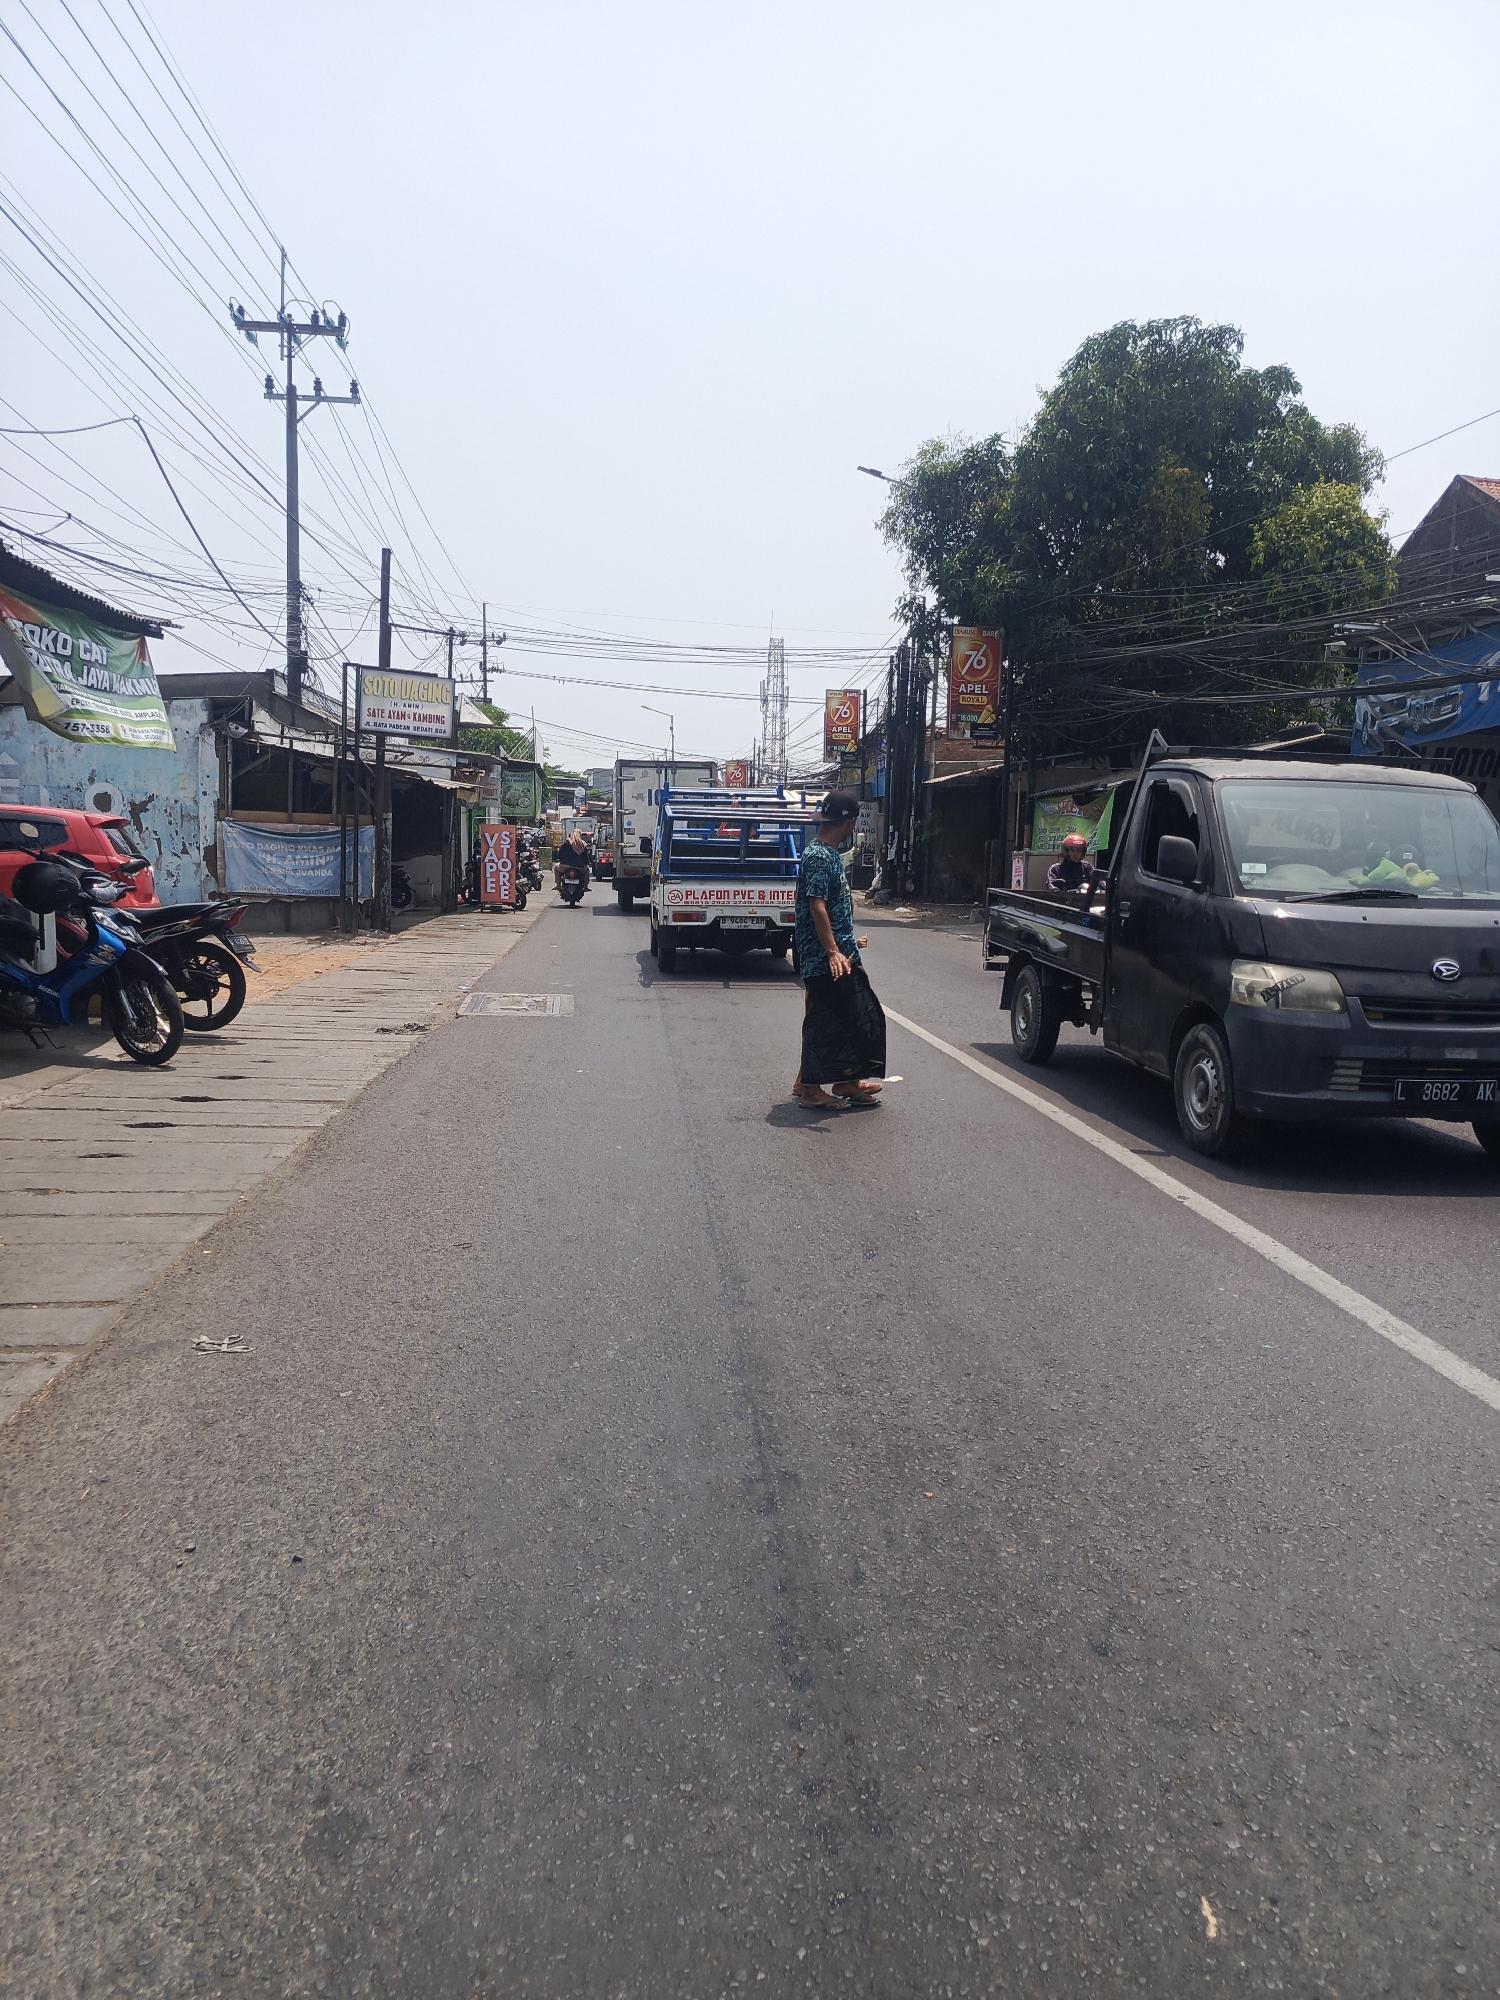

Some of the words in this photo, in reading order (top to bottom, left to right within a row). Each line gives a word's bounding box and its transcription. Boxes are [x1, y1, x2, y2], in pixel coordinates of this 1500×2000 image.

[78, 638, 108, 665] CAT
[961, 644, 987, 676] 76
[78, 665, 110, 692] JAYA
[959, 683, 989, 694] APEL
[364, 674, 398, 699] SOTO
[400, 679, 451, 705] DAGING
[961, 695, 986, 704] ROYAL
[366, 707, 385, 719] SATE
[387, 709, 406, 721] AYAM
[412, 712, 445, 725] KAMBING
[833, 701, 851, 722] 76
[226, 840, 255, 850] SOTO
[256, 843, 296, 852] DAGING
[297, 845, 324, 853] KHAS
[484, 832, 499, 893] VAPE
[498, 831, 512, 900] STORE
[685, 889, 730, 900] PLAFON
[733, 889, 755, 900] PVC
[758, 889, 766, 901] &
[769, 890, 797, 901] INTE
[1396, 1082, 1406, 1101] L
[1422, 1083, 1460, 1101] 3682
[1476, 1083, 1494, 1102] AK
